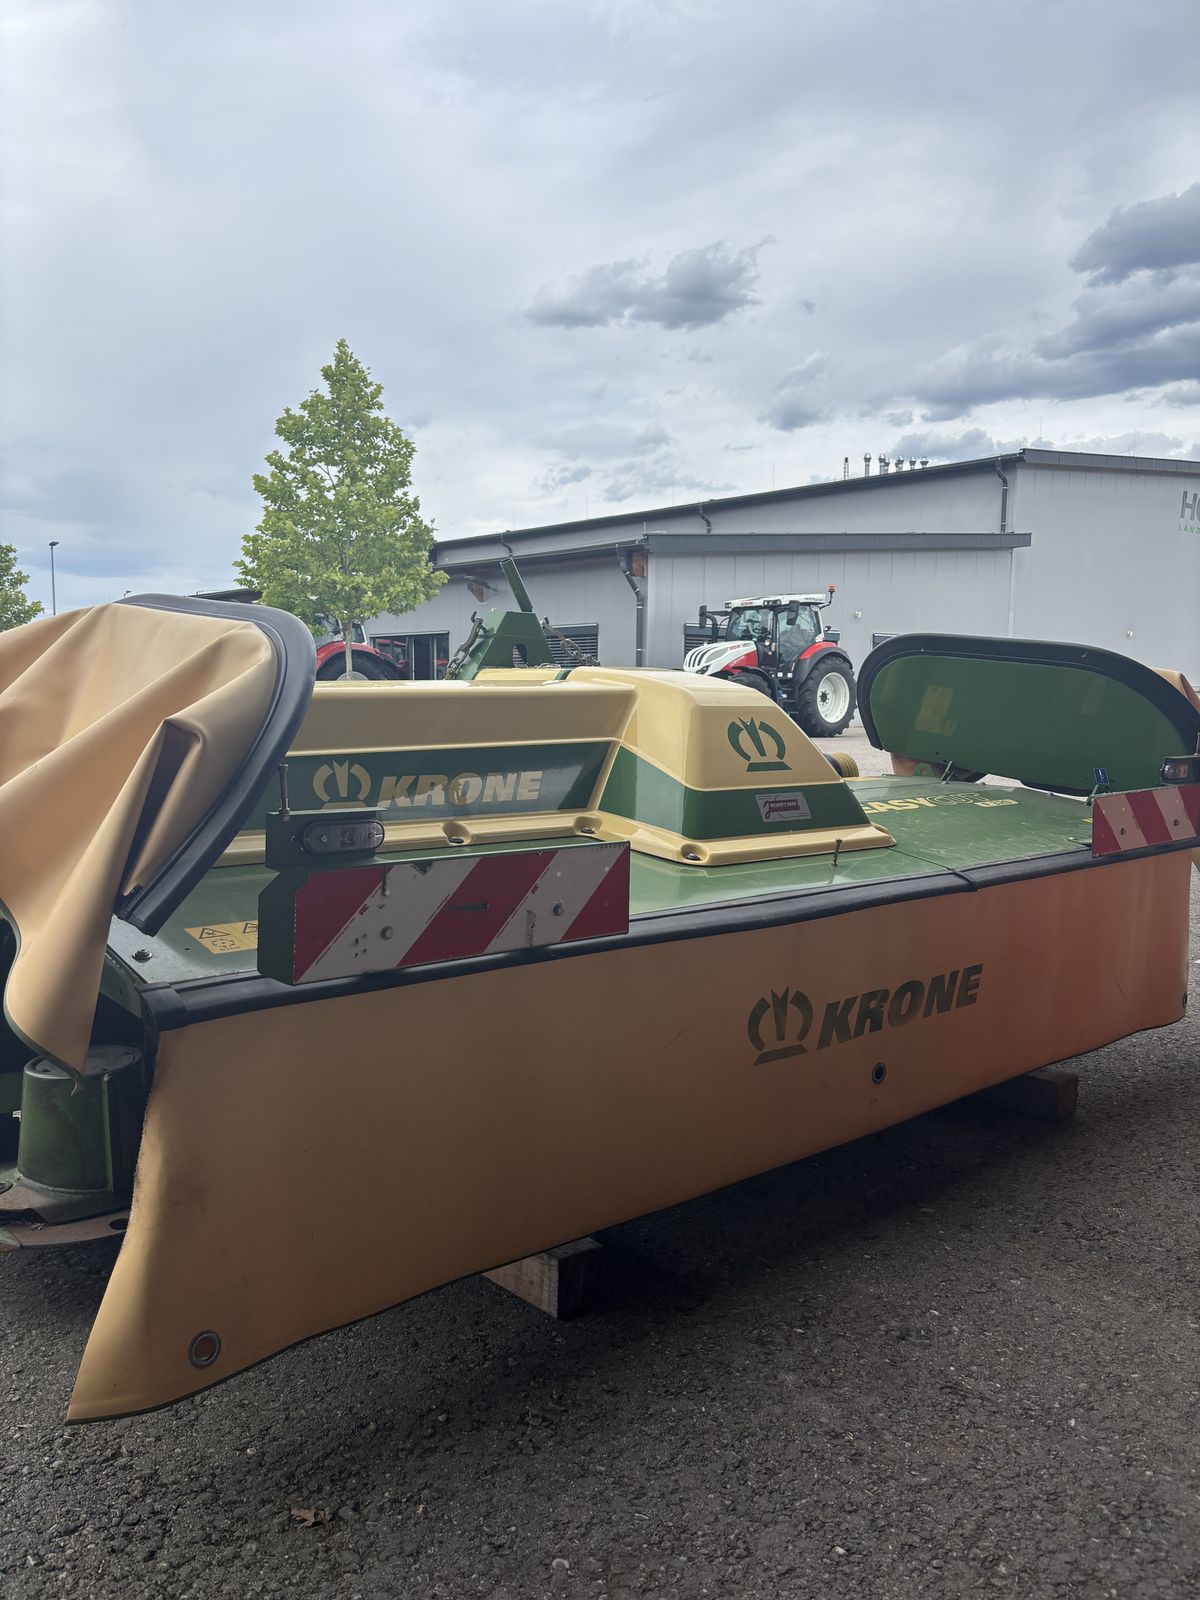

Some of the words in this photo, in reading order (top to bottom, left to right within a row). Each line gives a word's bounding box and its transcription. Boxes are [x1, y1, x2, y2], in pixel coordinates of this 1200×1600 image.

[1180, 490, 1200, 521] H
[376, 770, 543, 808] KRONE
[817, 963, 984, 1050] KRONE
